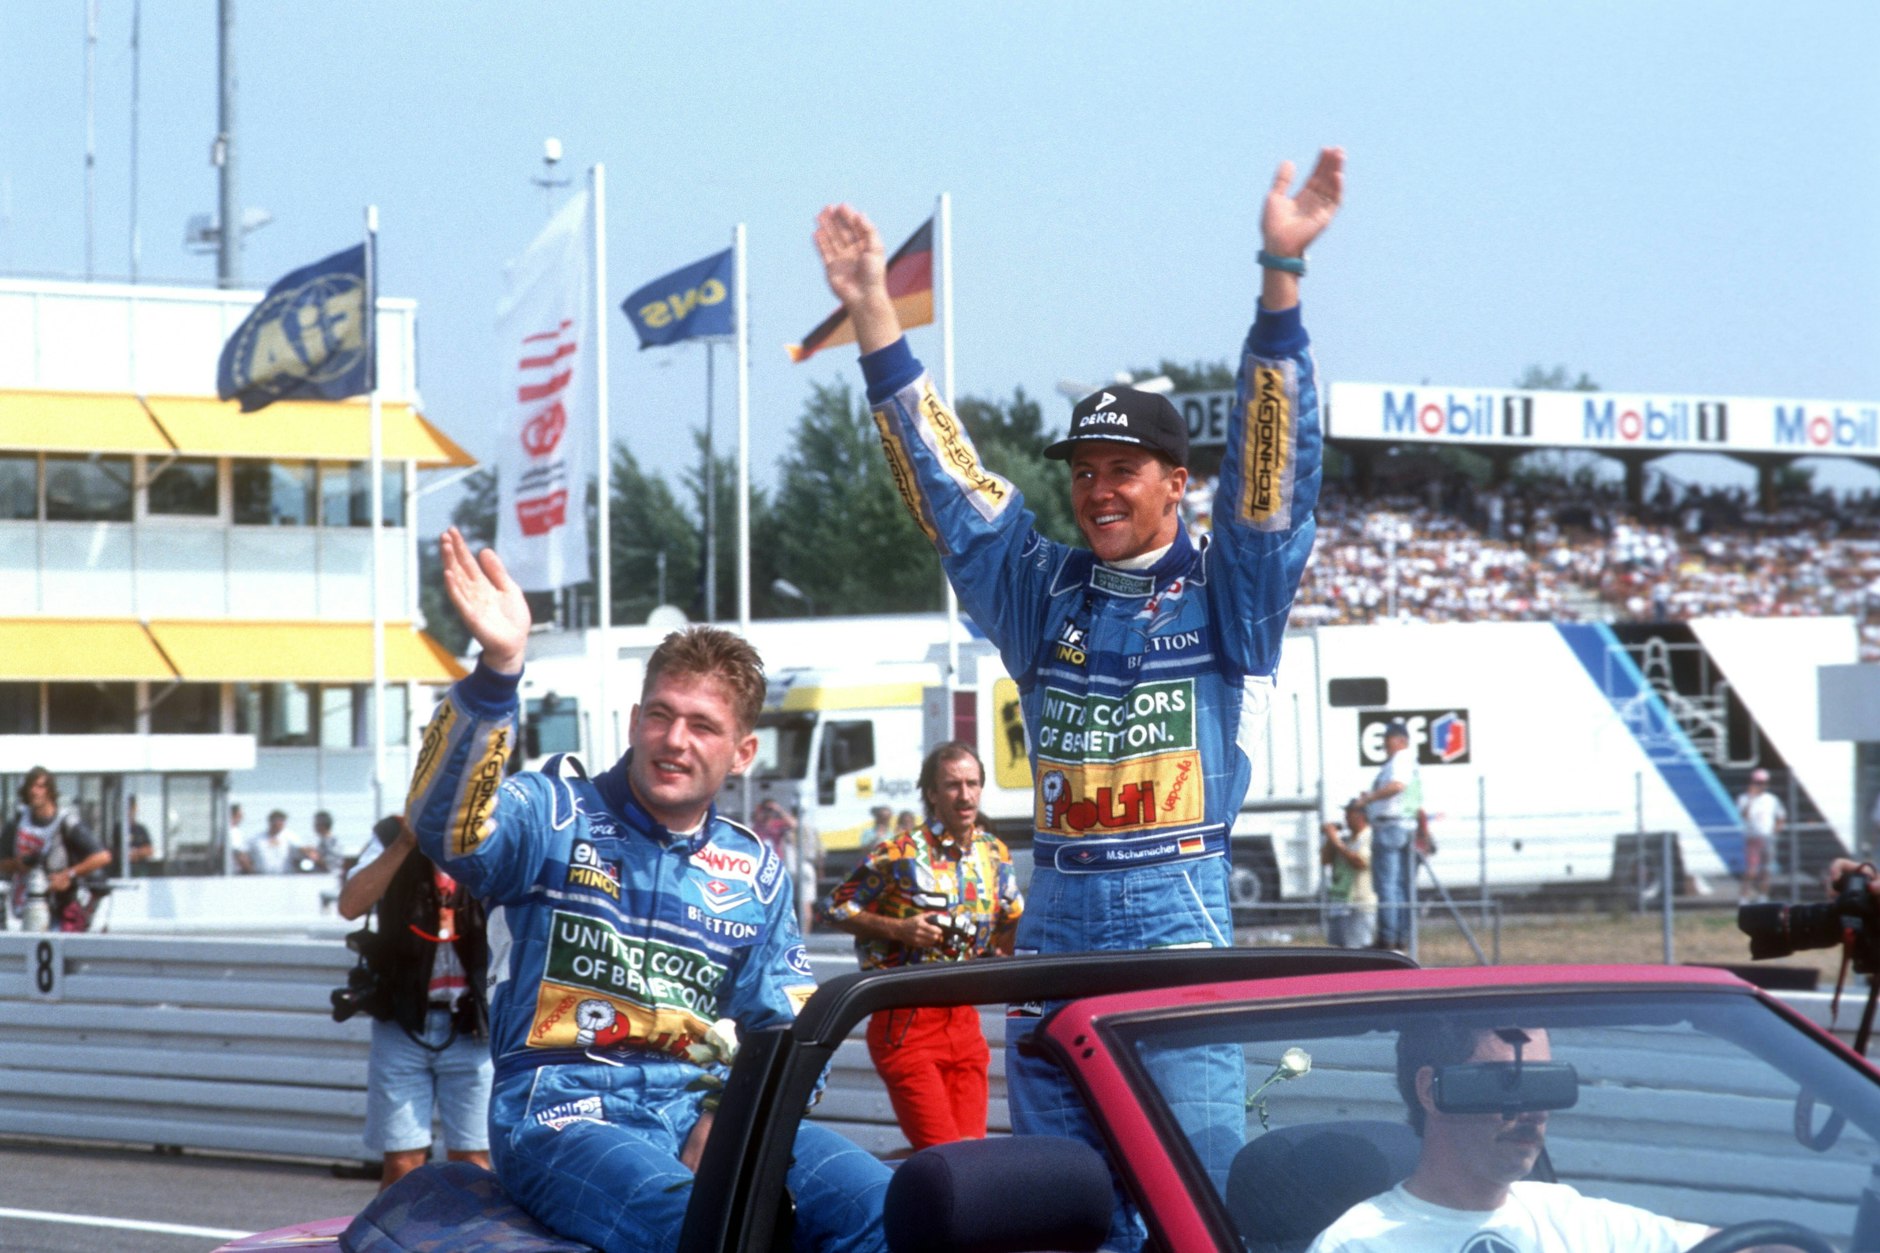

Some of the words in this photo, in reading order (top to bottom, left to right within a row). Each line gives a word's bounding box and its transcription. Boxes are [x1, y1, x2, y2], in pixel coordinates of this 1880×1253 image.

[1079, 411, 1129, 427] DEKRA
[1383, 390, 1493, 436] Mobil
[1584, 399, 1689, 442] Mobil
[1775, 404, 1878, 447] Mobil
[1251, 370, 1281, 517] TECHNOGYM
[1093, 689, 1186, 725] COLORS
[1039, 725, 1059, 748] OF
[1362, 716, 1427, 762] ef
[694, 848, 751, 875] SANYO
[1106, 844, 1176, 861] M.Schumacher
[569, 868, 620, 900] MINOL
[36, 939, 54, 994] 8
[573, 955, 607, 980] OF
